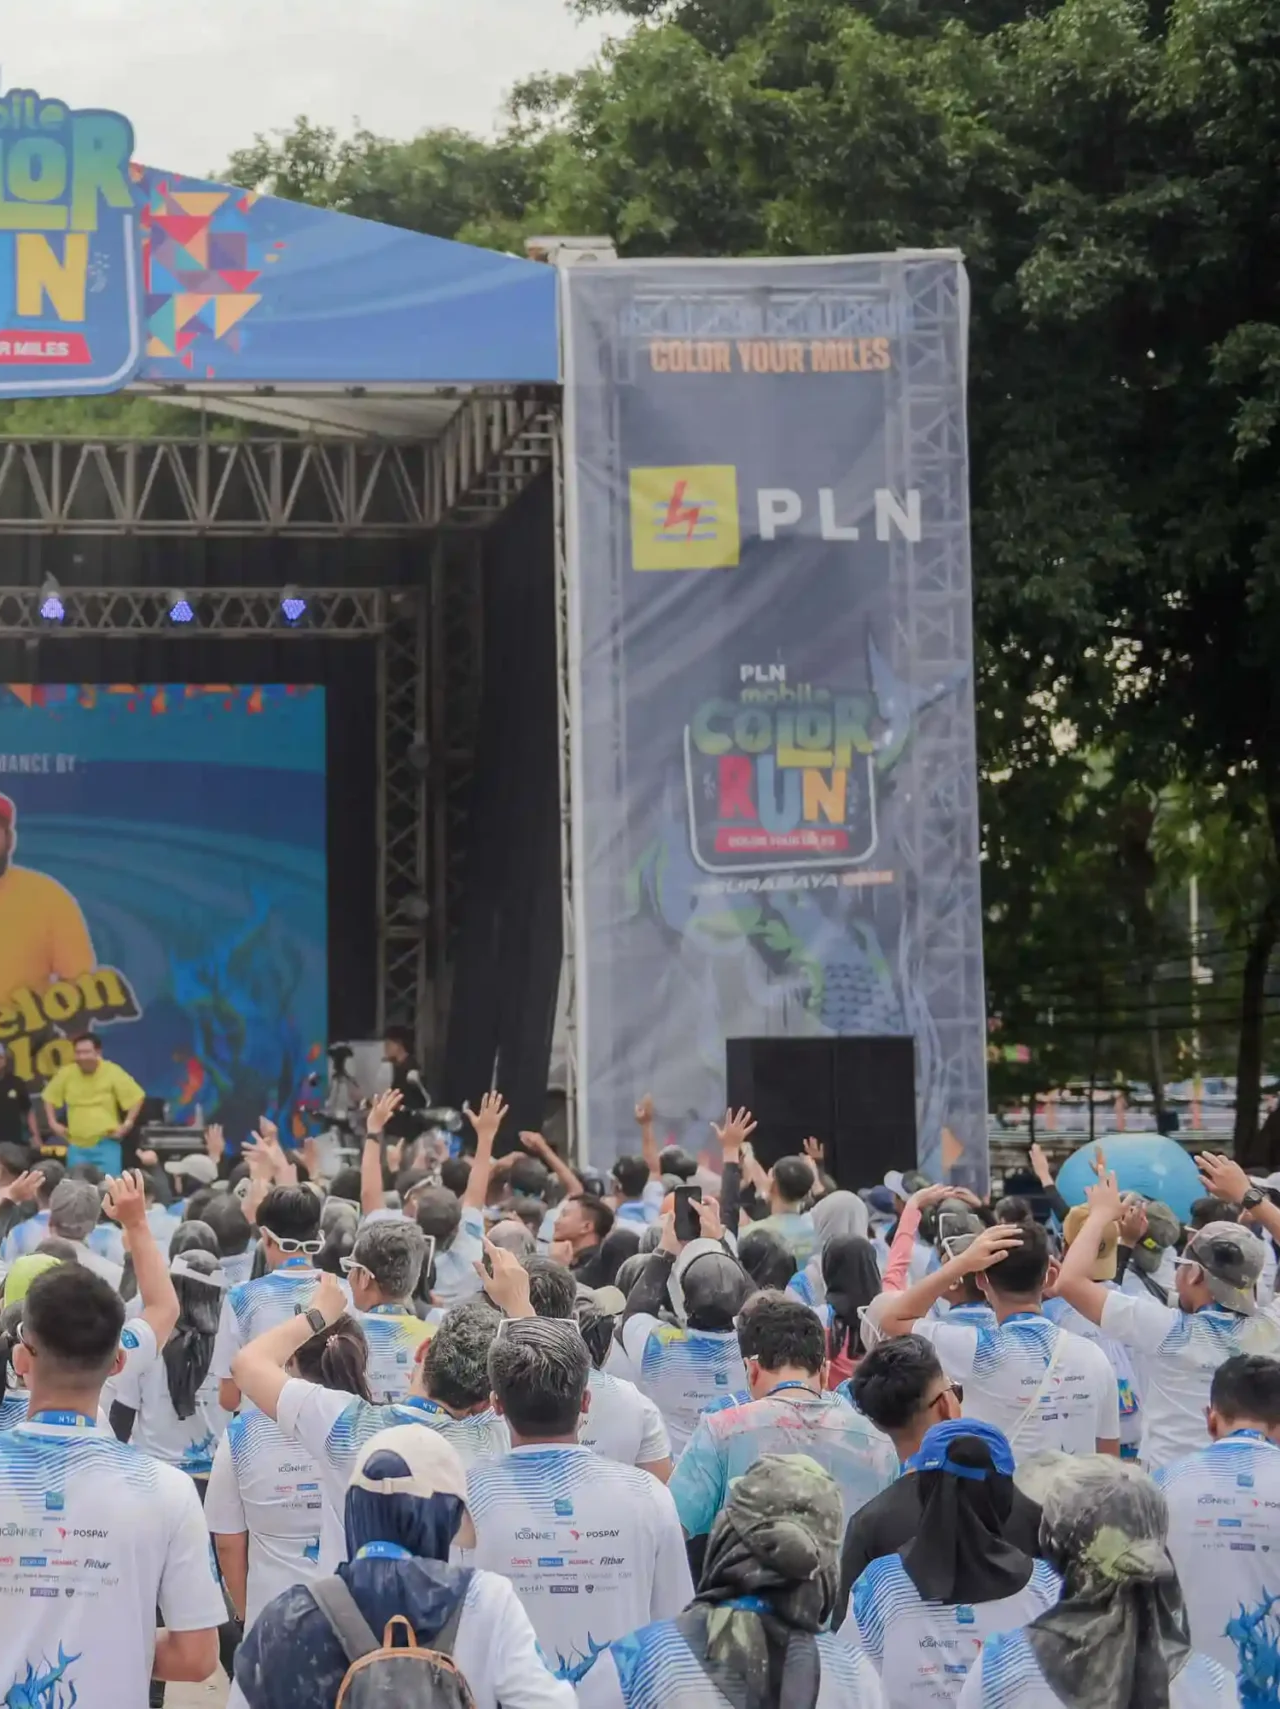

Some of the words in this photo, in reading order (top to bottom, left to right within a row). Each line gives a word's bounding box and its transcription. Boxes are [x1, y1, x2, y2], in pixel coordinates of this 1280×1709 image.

[14, 341, 68, 356] MILES
[650, 339, 731, 373] COLOR
[736, 339, 805, 373] YOUR
[810, 337, 891, 373] MILES
[757, 488, 921, 542] PLN
[740, 664, 786, 682] PLN
[692, 697, 874, 767] COLOR
[56, 754, 76, 773] BY
[718, 754, 848, 834] RUN
[73, 1529, 109, 1538] POSPAY
[515, 1531, 557, 1541] ICONNET
[586, 1529, 620, 1539] POSPAY
[83, 1558, 112, 1569] Fitbar
[600, 1556, 625, 1565] Fitbar
